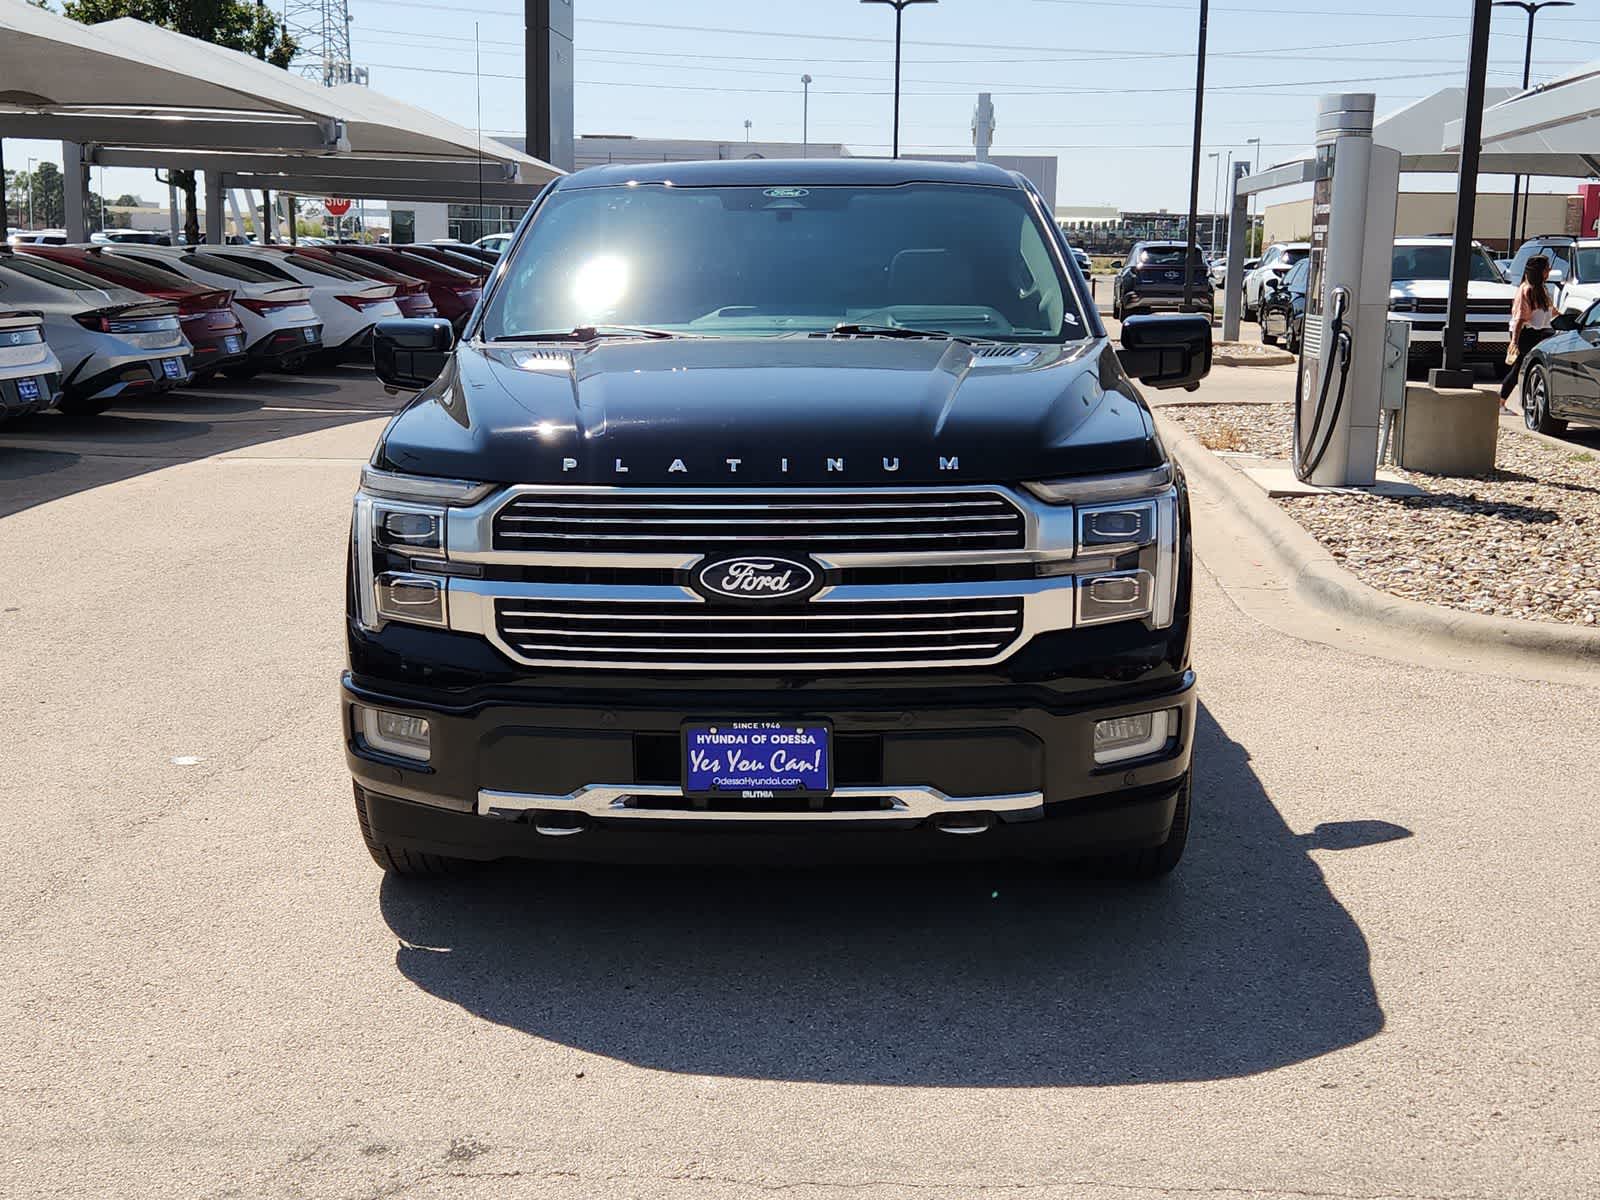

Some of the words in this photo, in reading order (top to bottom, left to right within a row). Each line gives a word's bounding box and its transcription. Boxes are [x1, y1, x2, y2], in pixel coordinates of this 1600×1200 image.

[562, 457, 960, 473] PLATINUM
[722, 563, 791, 592] Ford
[697, 735, 748, 744] HYUNDAI
[751, 735, 767, 744] OF
[771, 735, 815, 744] ODESSA
[690, 749, 721, 772] Yes
[727, 749, 765, 772] You
[769, 749, 821, 772] Can!
[713, 777, 801, 786] OdessaHyundai.com
